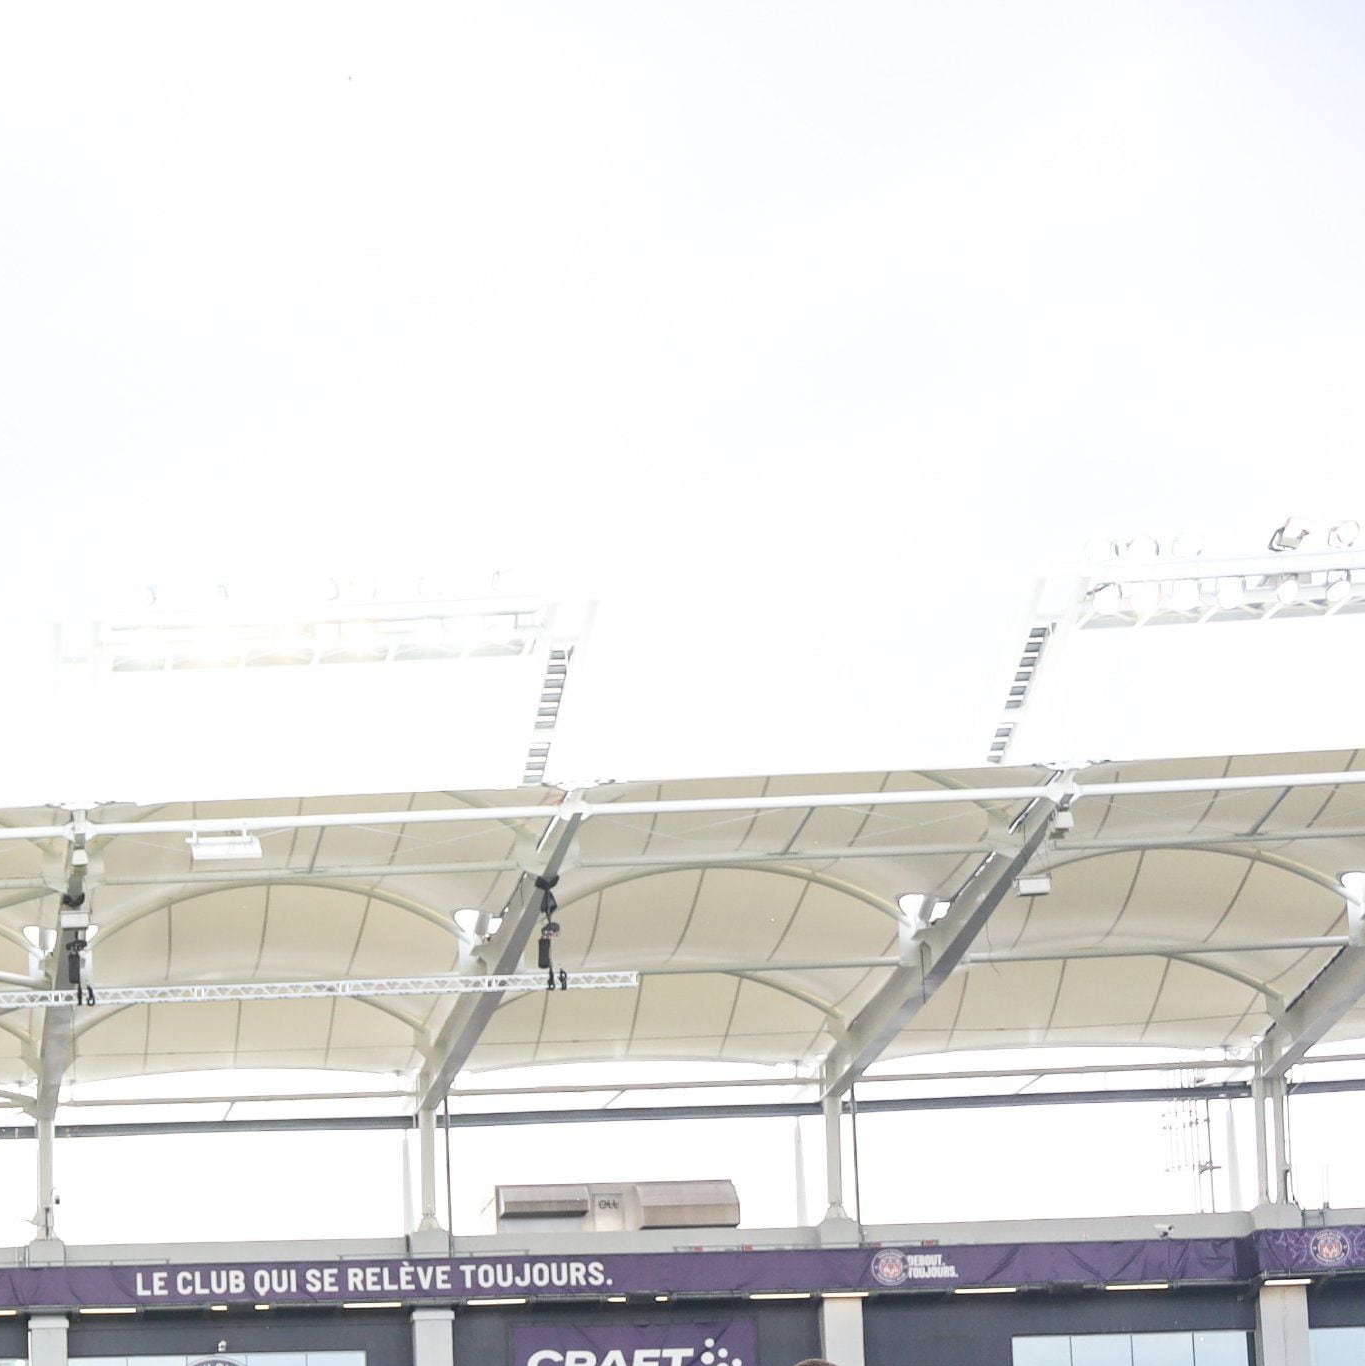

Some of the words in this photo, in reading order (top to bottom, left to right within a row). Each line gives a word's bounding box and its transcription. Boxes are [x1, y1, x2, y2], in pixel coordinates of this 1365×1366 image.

[135, 1272, 168, 1295] LE
[177, 1270, 245, 1295] CLUB
[253, 1269, 297, 1295] QUI
[306, 1268, 338, 1292] SE
[347, 1260, 452, 1291] RELÈVE
[462, 1261, 613, 1289] TOUJOURS.
